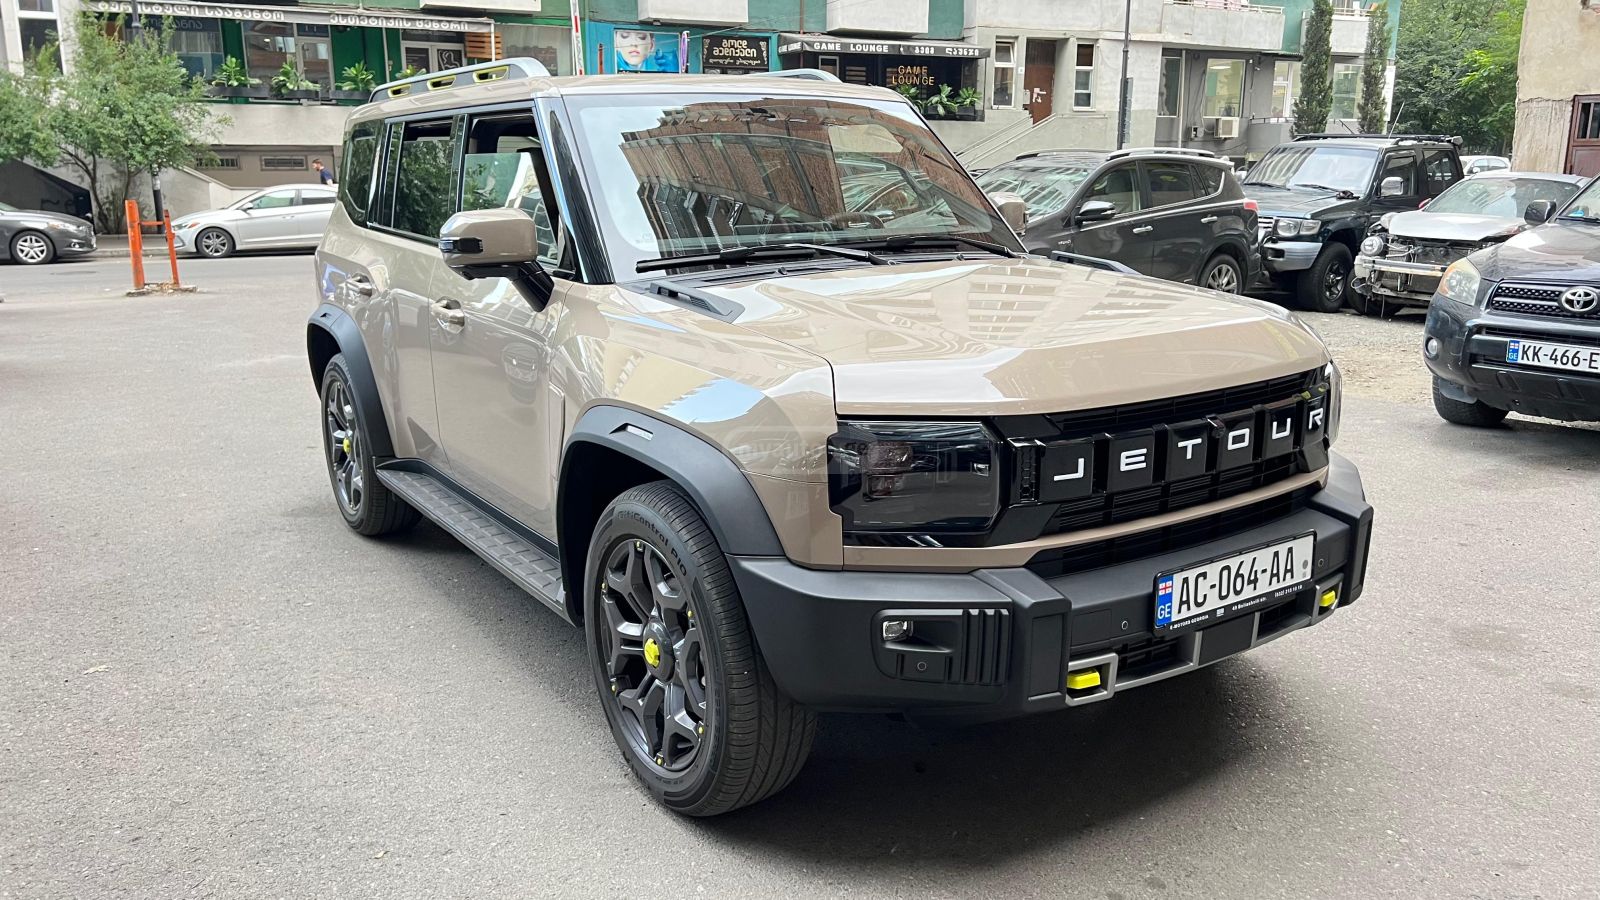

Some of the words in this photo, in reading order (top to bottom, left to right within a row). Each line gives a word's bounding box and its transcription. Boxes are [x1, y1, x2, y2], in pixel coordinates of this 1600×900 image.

[204, 8, 285, 21] სააგენტო
[329, 13, 412, 28] ესთეტიკის
[415, 17, 469, 31] ცენტრი
[813, 41, 841, 51] GAME
[849, 43, 889, 53] LOUNGE
[897, 65, 929, 75] GAME
[892, 75, 935, 86] LOUNGE
[1508, 352, 1518, 360] GE
[1521, 344, 1600, 370] KK-466-E
[1053, 406, 1324, 481] JETOUR
[1157, 602, 1171, 620] GE
[1177, 546, 1295, 614] AC-064-AA
